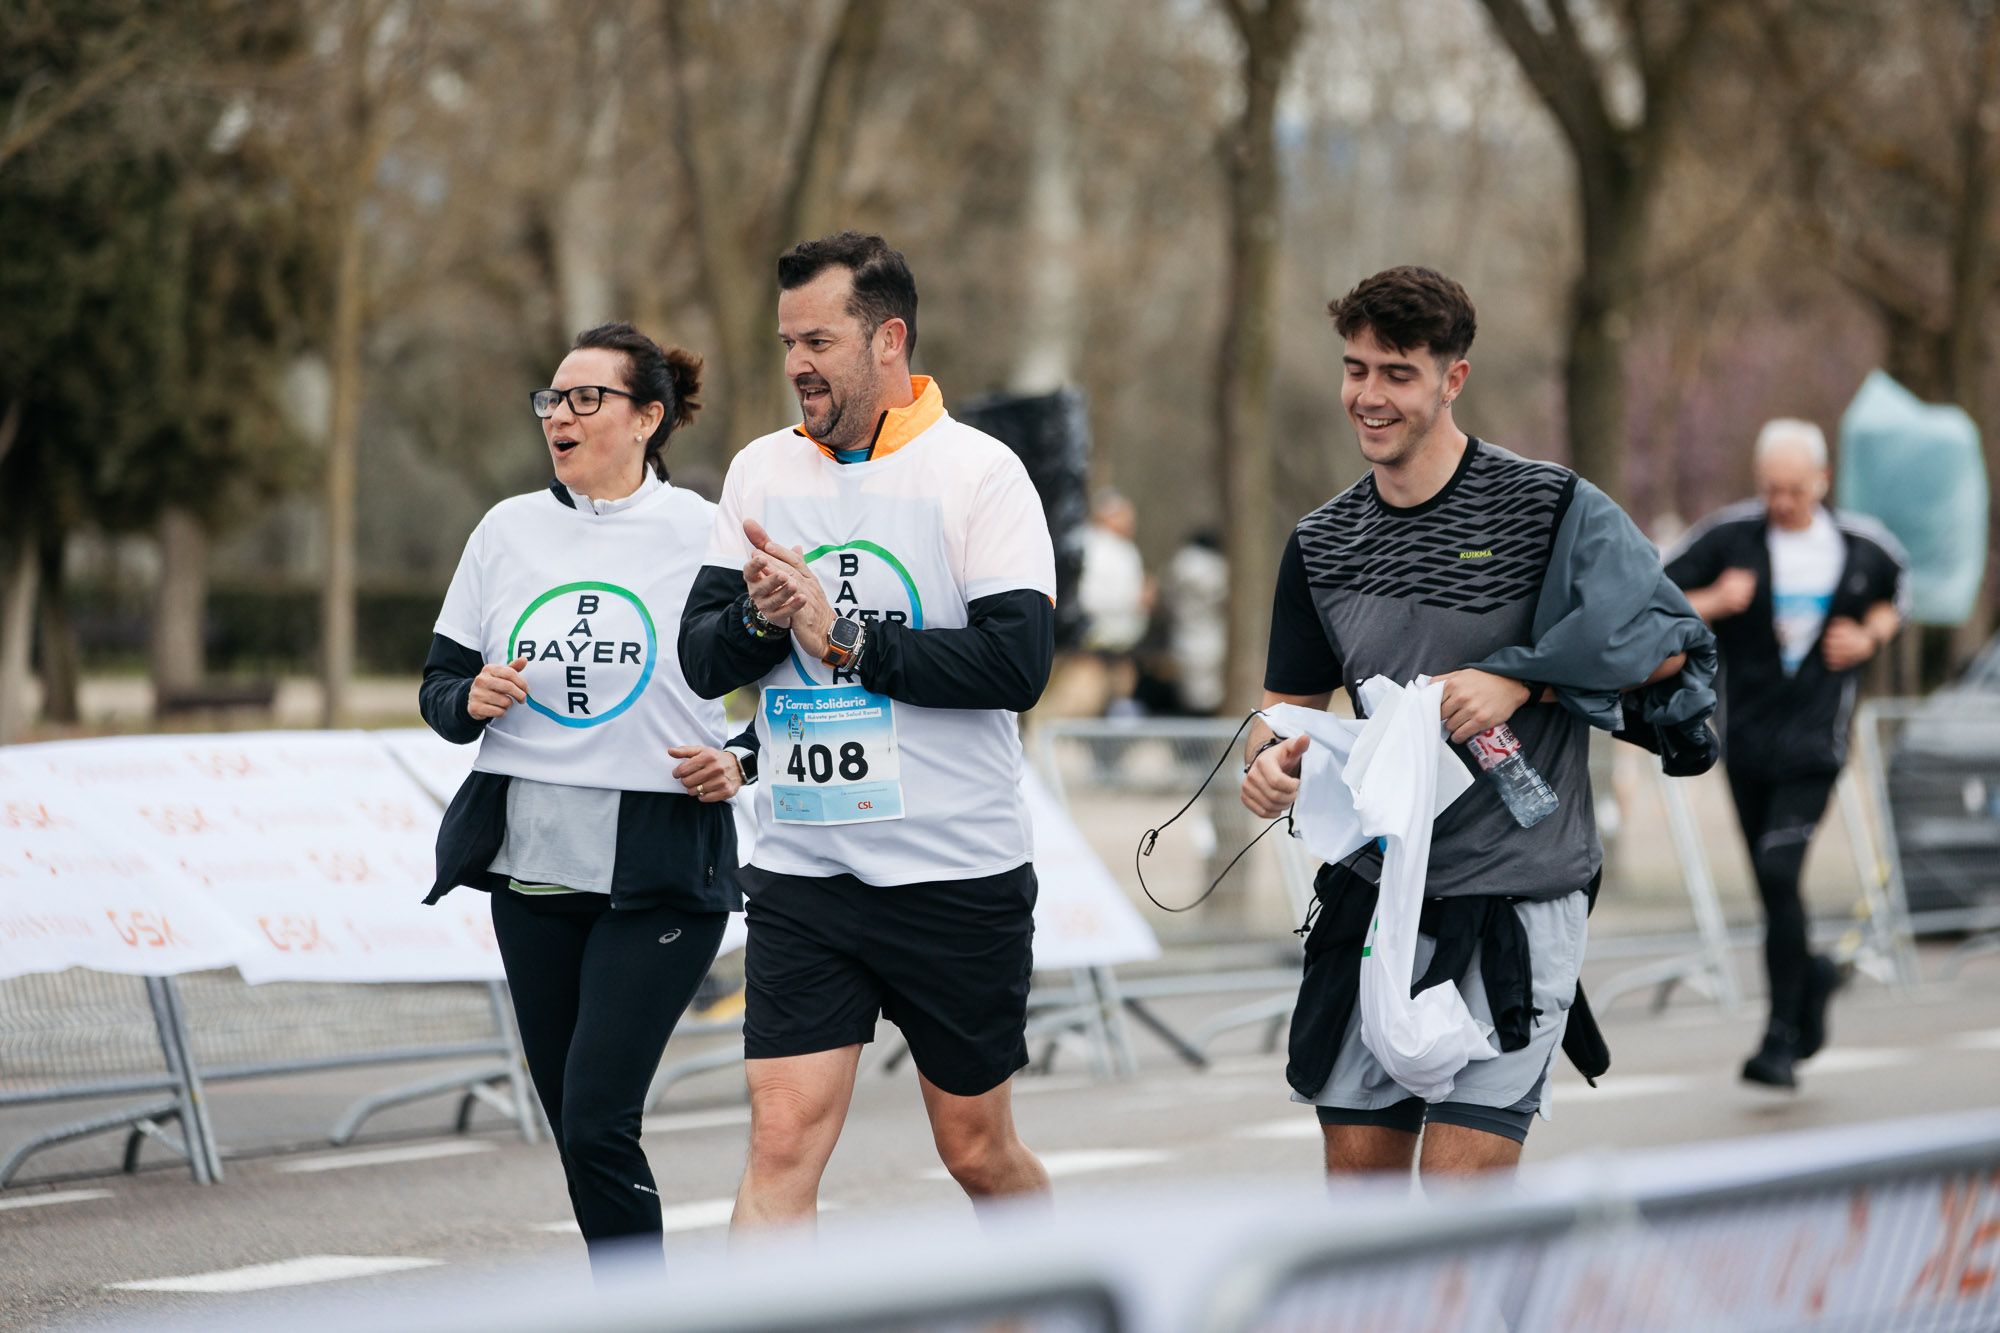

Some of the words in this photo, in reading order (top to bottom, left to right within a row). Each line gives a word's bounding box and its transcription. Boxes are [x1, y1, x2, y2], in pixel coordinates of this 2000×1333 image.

[1459, 548, 1493, 560] KUIKMA
[517, 640, 642, 665] BAYER
[566, 594, 600, 715] BAYER
[815, 696, 867, 710] Solidaria
[787, 741, 869, 784] 408
[857, 800, 874, 810] CSL
